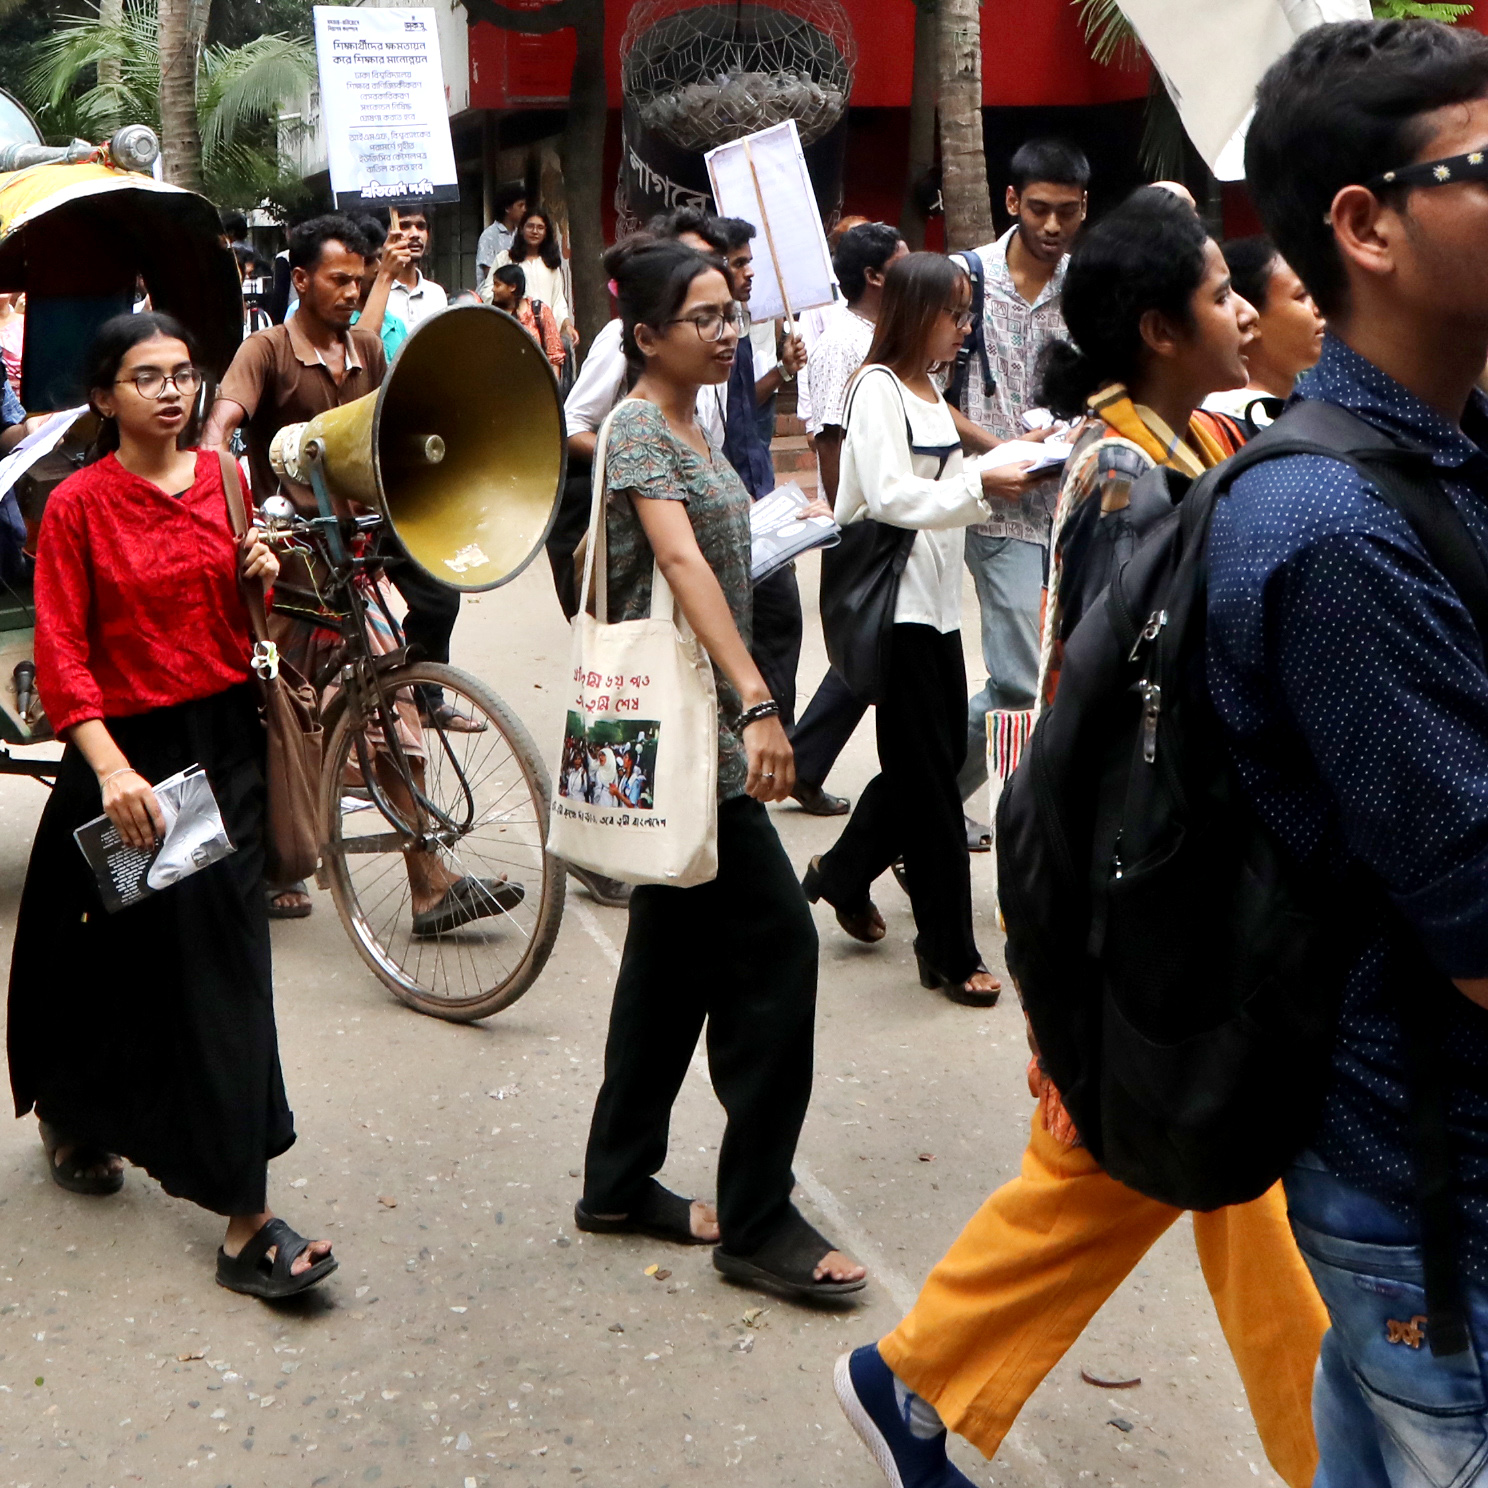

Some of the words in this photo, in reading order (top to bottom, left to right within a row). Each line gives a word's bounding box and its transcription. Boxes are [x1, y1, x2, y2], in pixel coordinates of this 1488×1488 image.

[333, 38, 383, 51] শিক্ষার্থীদের
[385, 42, 425, 51] ক্ষমতায়ন
[332, 56, 352, 64] করে
[353, 53, 384, 64] শিক্ষার
[585, 695, 610, 713] তুমি
[615, 697, 639, 712] শেষ
